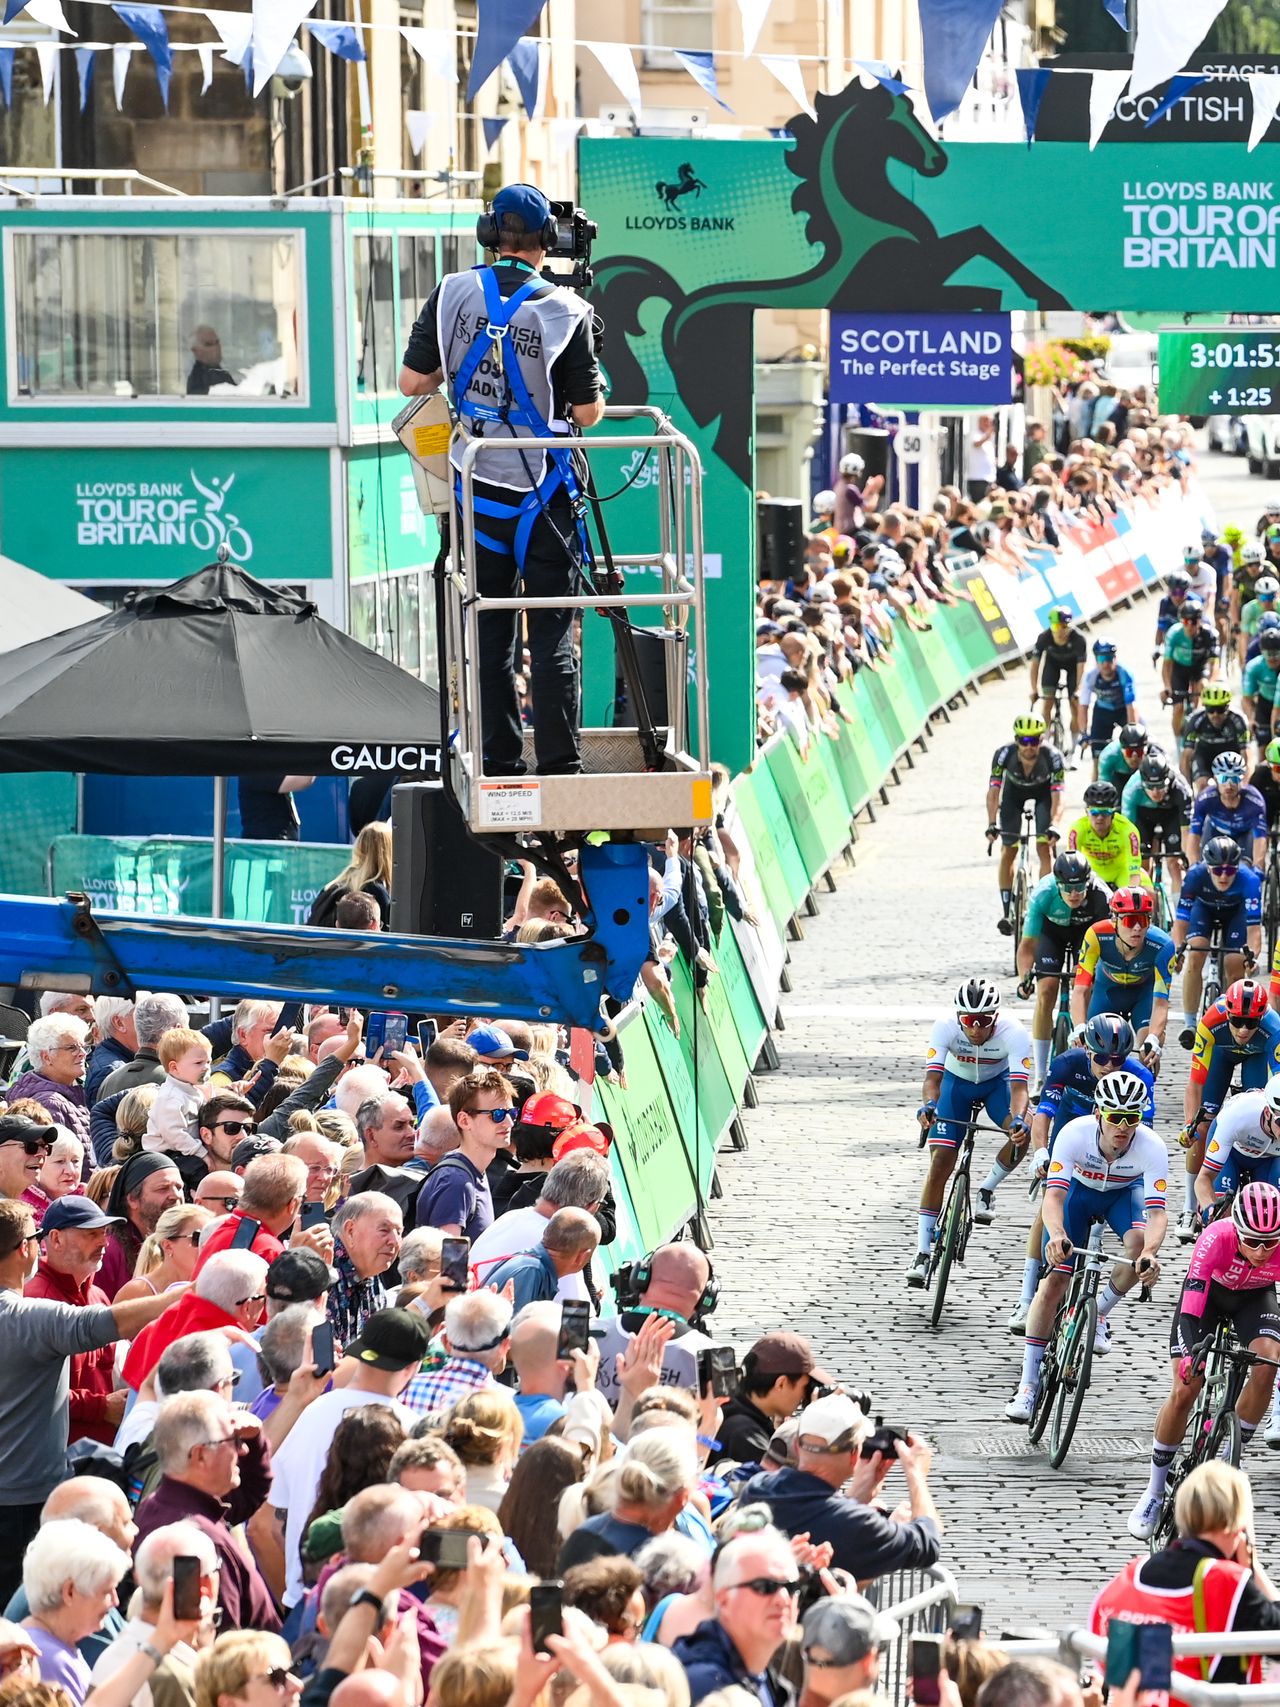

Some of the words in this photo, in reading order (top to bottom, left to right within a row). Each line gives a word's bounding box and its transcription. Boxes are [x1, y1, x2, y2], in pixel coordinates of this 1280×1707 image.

[1123, 182, 1208, 200] LLOYDS
[1213, 182, 1275, 200] BANK
[625, 216, 687, 230] LLOYDS
[690, 217, 735, 231] BANK
[1123, 205, 1235, 236] TOUR
[1123, 237, 1276, 268] BRITAIN
[840, 329, 1002, 355] SCOTLAND
[840, 359, 875, 377] The
[879, 358, 945, 377] Perfect
[949, 359, 1001, 380] Stage
[1227, 387, 1272, 406] 1:25
[902, 437, 920, 453] 50
[76, 483, 136, 497] LLOYDS
[140, 483, 183, 497] BANK
[77, 499, 156, 522] TOUR
[157, 499, 197, 522] OF
[77, 522, 186, 545] BRITAIN
[1196, 1232, 1218, 1260] RYSEL
[1192, 1260, 1203, 1279] VAN
[1088, 1272, 1097, 1294] BMC
